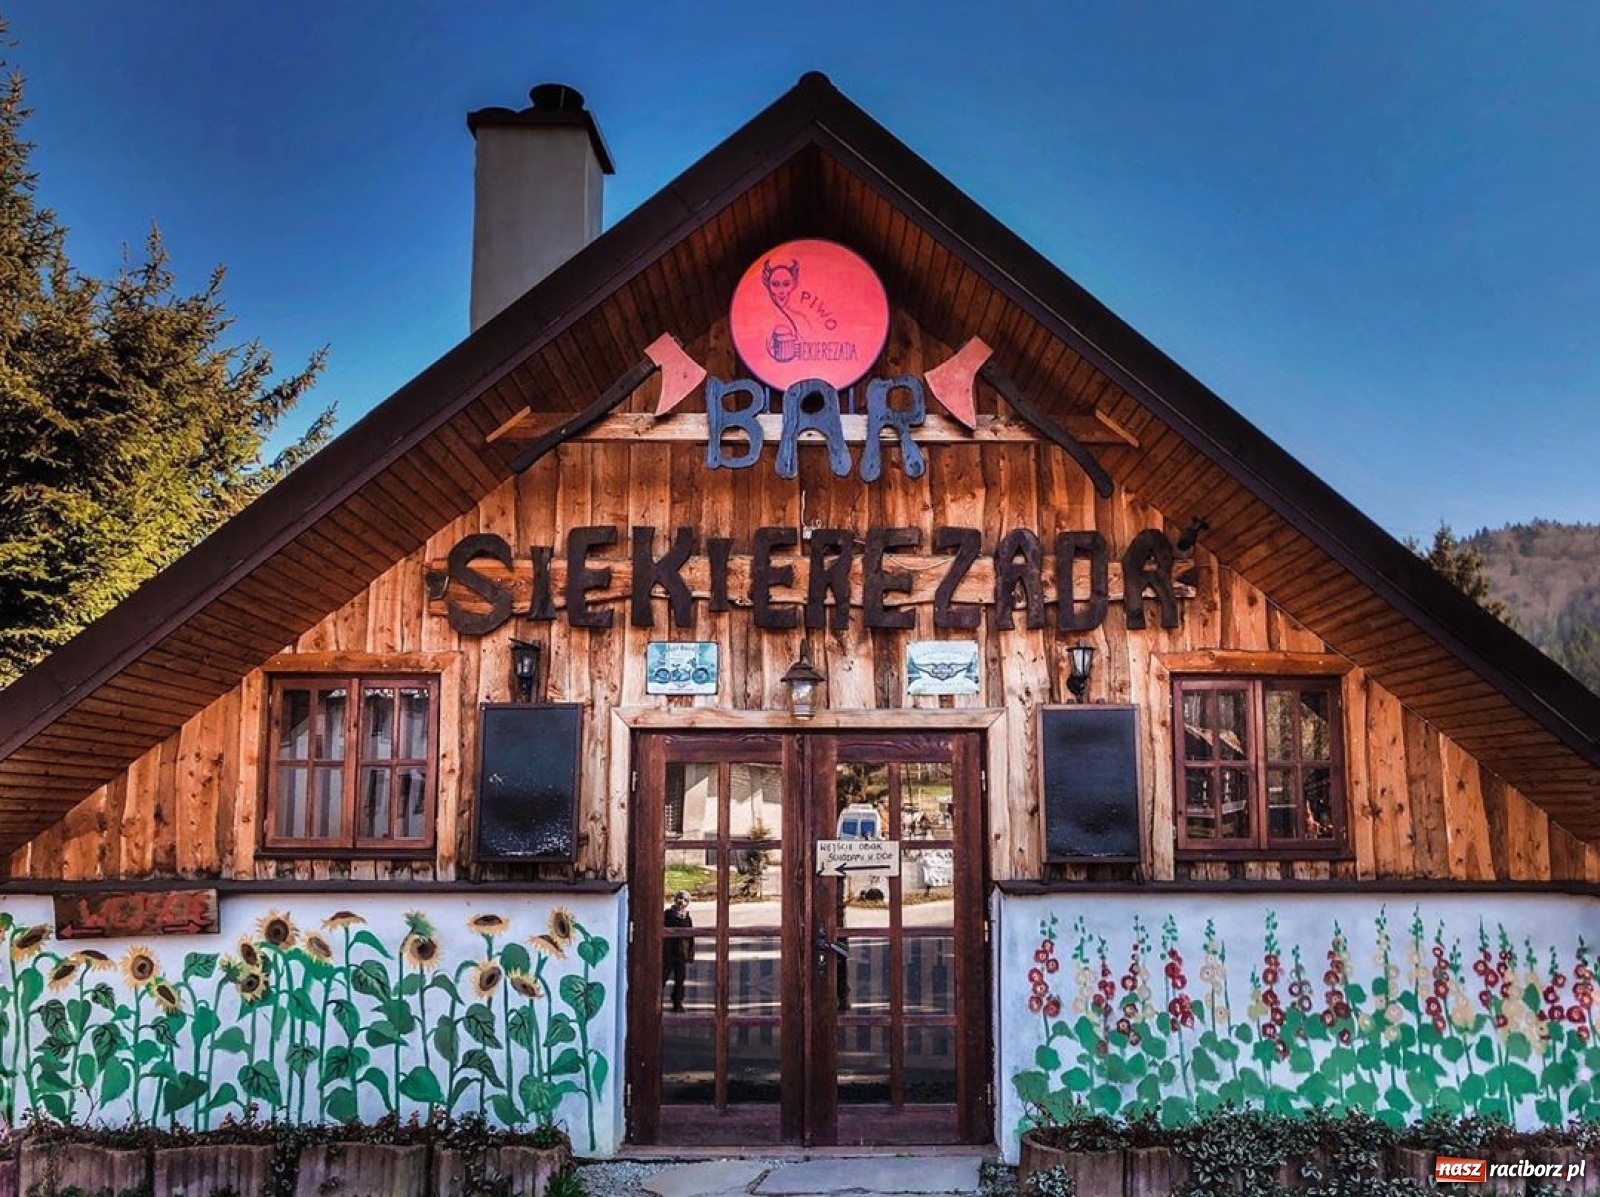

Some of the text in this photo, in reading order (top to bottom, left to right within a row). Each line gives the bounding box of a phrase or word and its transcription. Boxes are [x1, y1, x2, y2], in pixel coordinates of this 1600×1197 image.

[800, 291, 838, 331] PIWO
[705, 376, 927, 483] BAR
[446, 526, 1179, 636] SIEKIEREZADA
